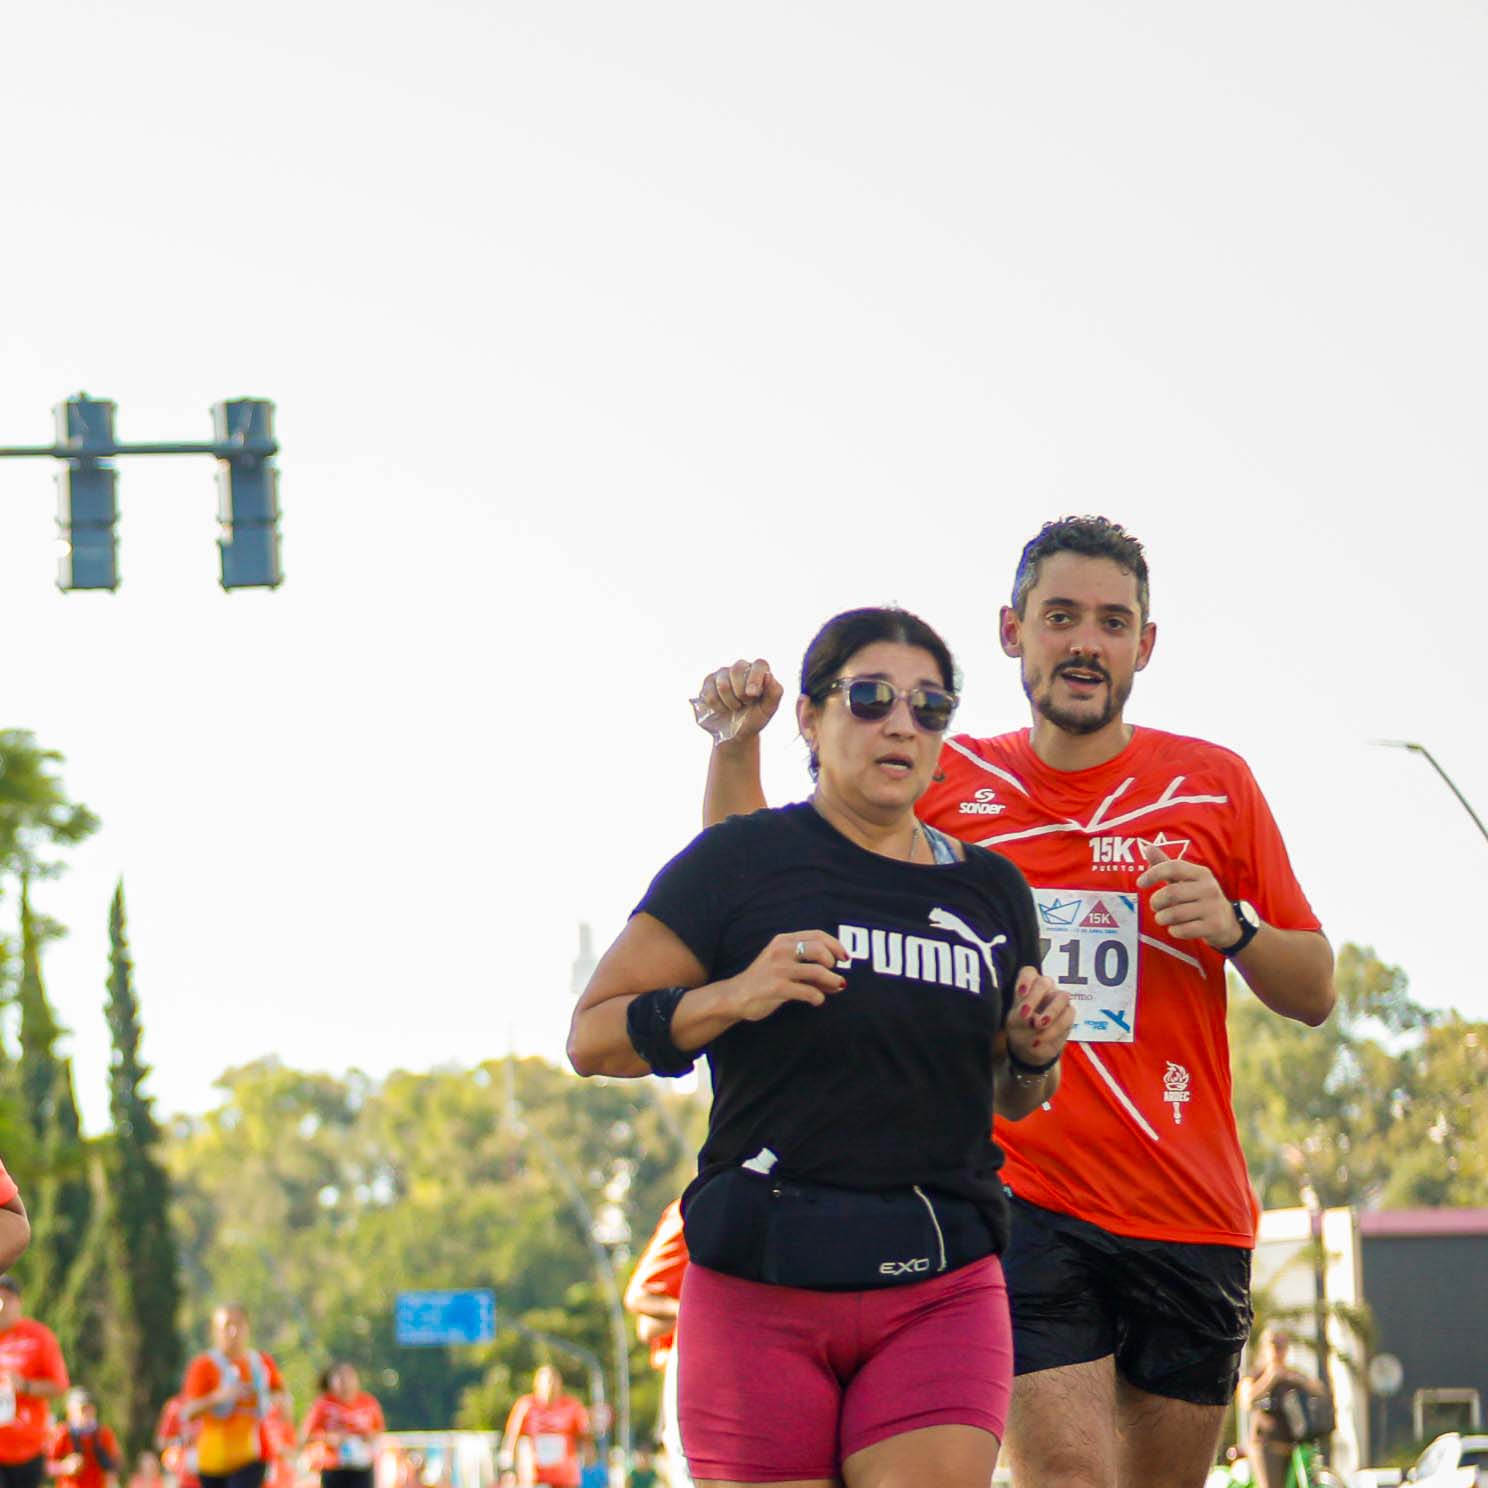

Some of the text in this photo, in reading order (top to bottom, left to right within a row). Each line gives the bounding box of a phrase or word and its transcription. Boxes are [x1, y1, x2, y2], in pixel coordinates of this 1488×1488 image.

[1089, 836, 1136, 863] 15K
[1089, 912, 1111, 924] 15K
[836, 925, 981, 994] PUMA
